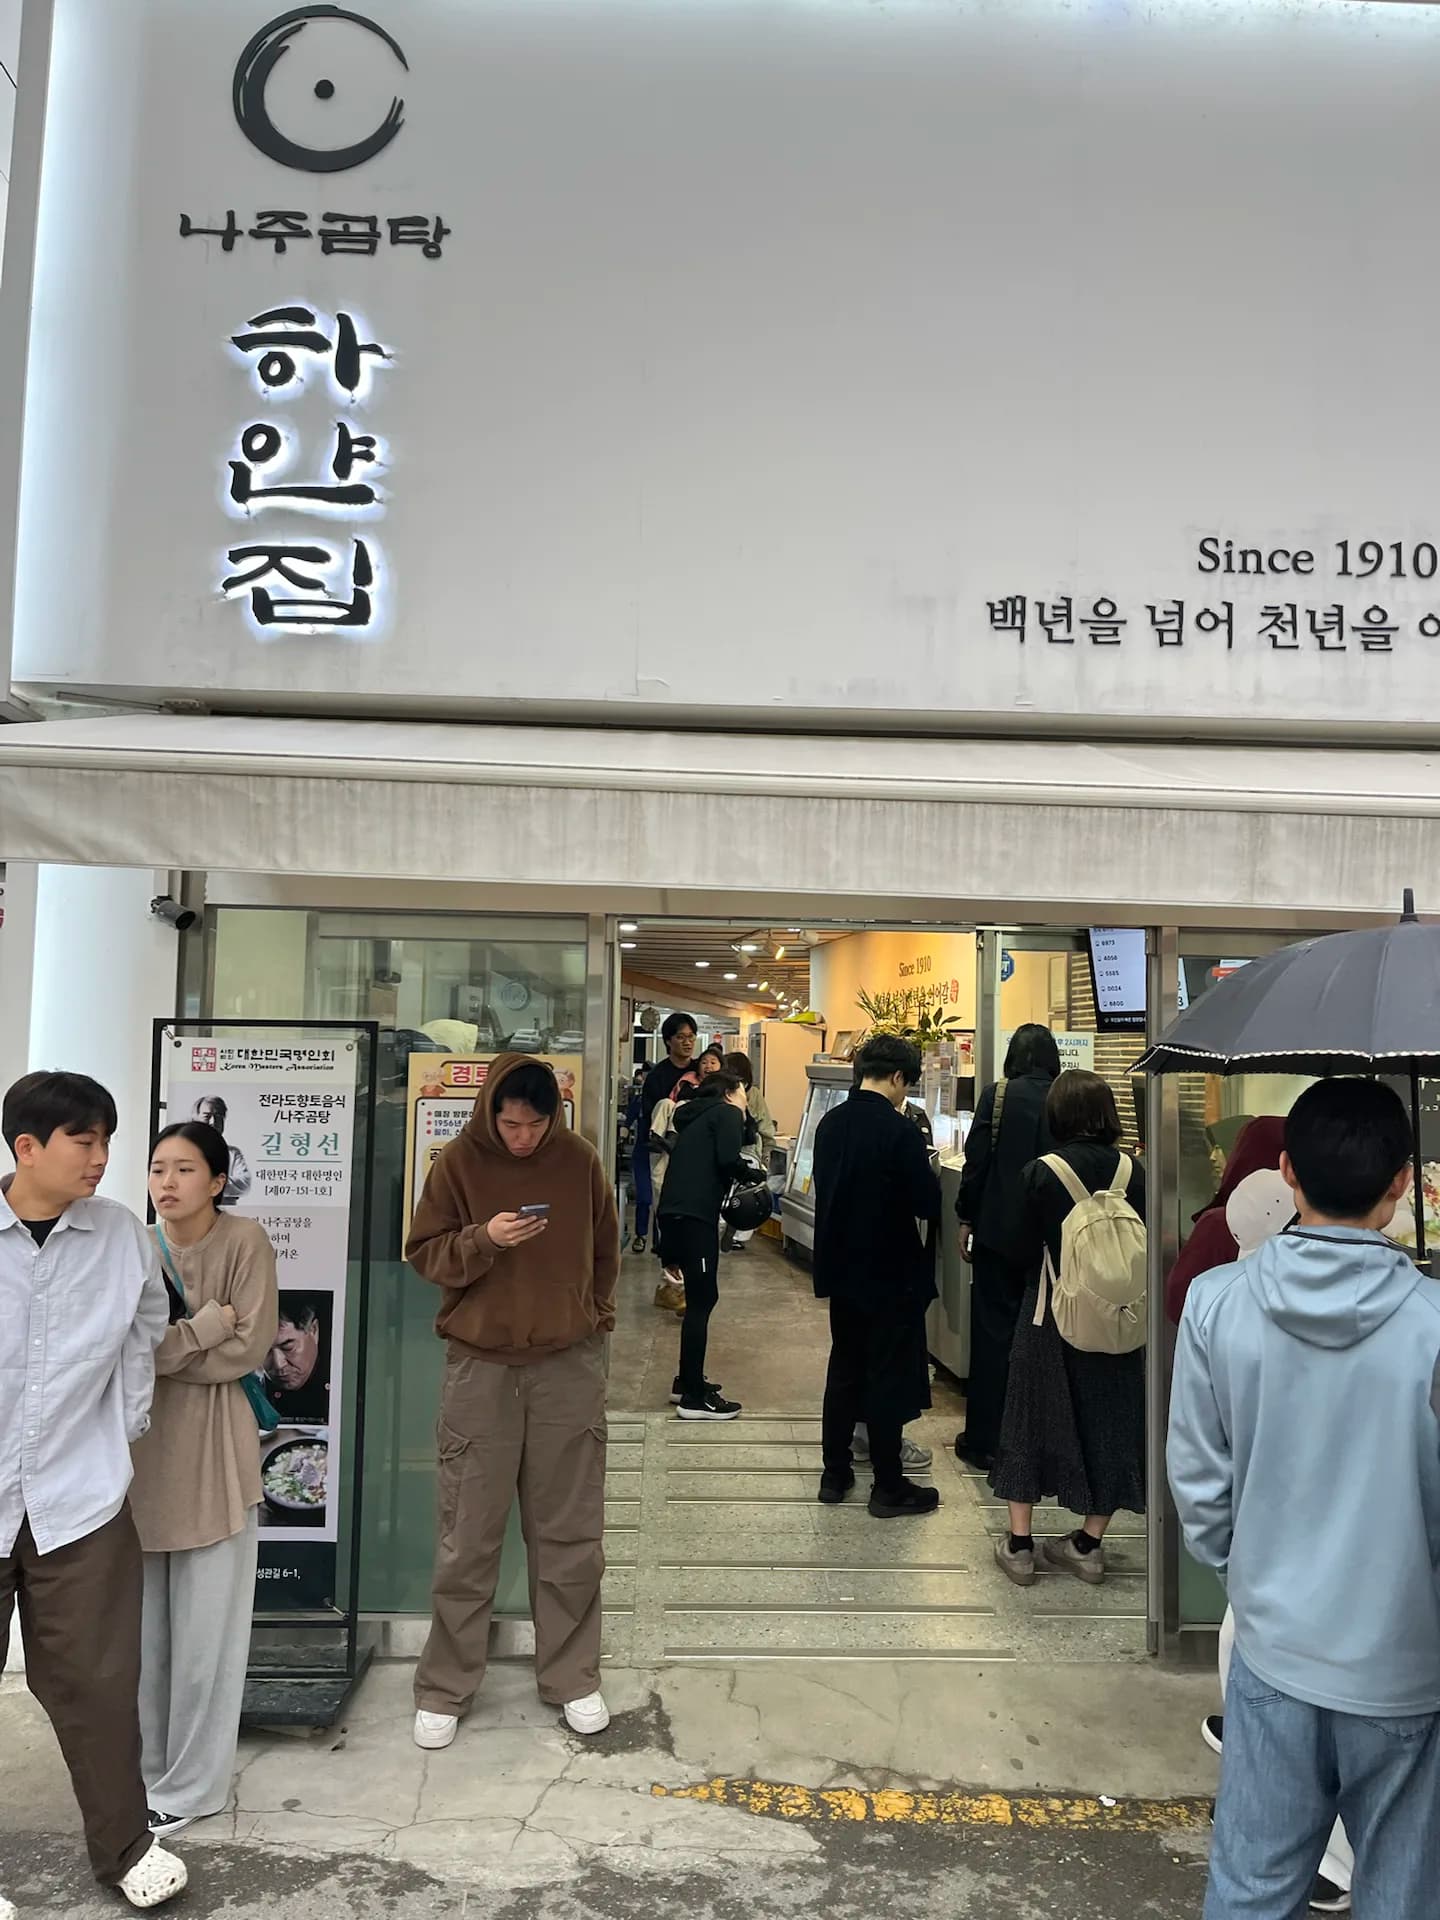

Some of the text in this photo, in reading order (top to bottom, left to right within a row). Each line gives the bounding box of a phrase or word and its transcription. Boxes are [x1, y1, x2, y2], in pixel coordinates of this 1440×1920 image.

[180, 210, 452, 260] 나주곰탕
[222, 306, 394, 627] 하얀집
[1197, 537, 1438, 579] Since 1910
[986, 594, 1128, 645] 백년을
[1145, 599, 1235, 650] 넘어
[1257, 602, 1400, 652] 천년을
[916, 955, 932, 974] 1910
[237, 1048, 335, 1061] 대한민국명인회
[258, 1094, 346, 1108] 전라도향토음식
[273, 1109, 332, 1124] /나주곰탕
[434, 1119, 462, 1128] 1956년
[255, 1169, 343, 1182] 대한민국 대한명인
[262, 1216, 313, 1229] 나주곰탕을
[282, 1568, 301, 1580] 6-1,
